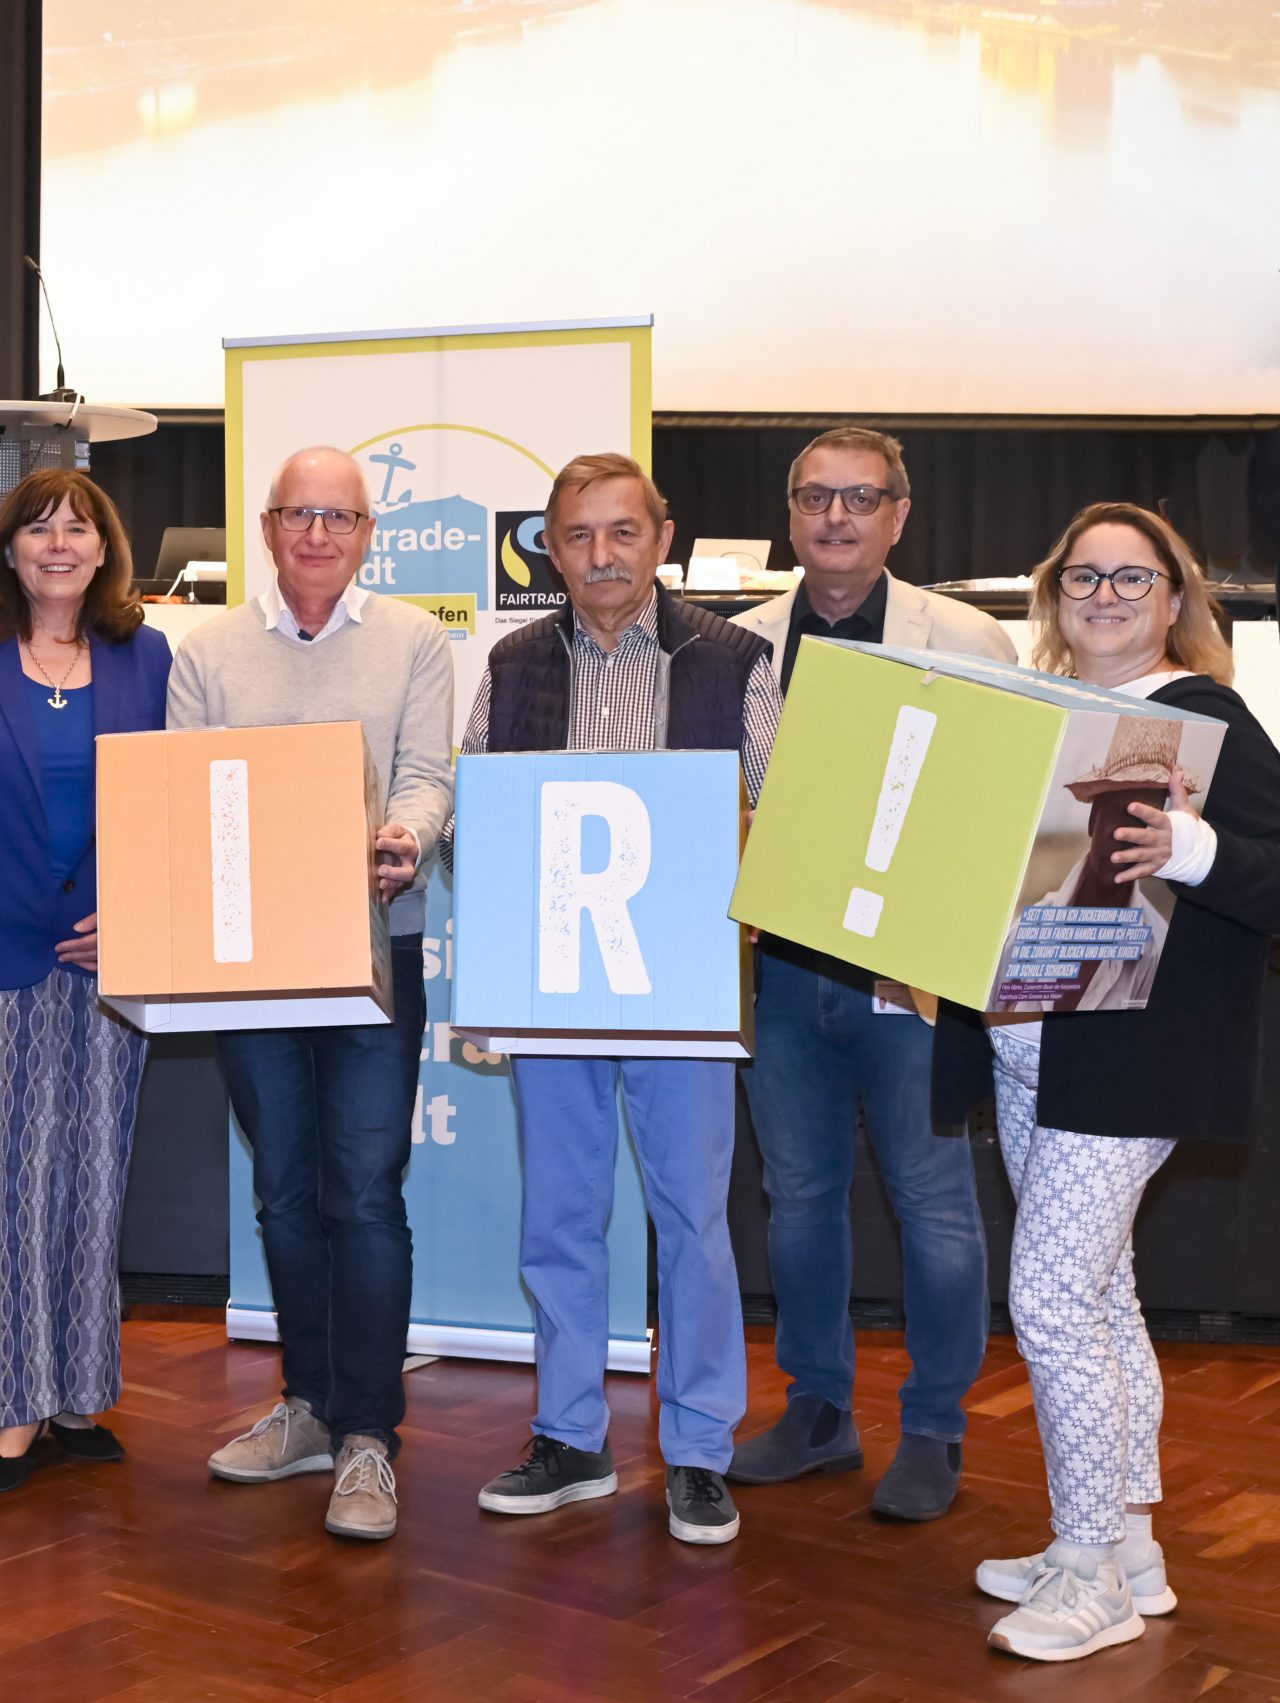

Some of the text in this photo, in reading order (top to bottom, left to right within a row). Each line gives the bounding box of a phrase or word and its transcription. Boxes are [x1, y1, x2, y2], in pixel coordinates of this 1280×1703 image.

[370, 520, 481, 553] trade-
[500, 592, 570, 606] FAIRTRAD
[509, 617, 528, 625] Siegel
[843, 705, 938, 938] !
[210, 759, 252, 963] I
[538, 781, 652, 994] R
[1020, 964, 1045, 977] SCHULE
